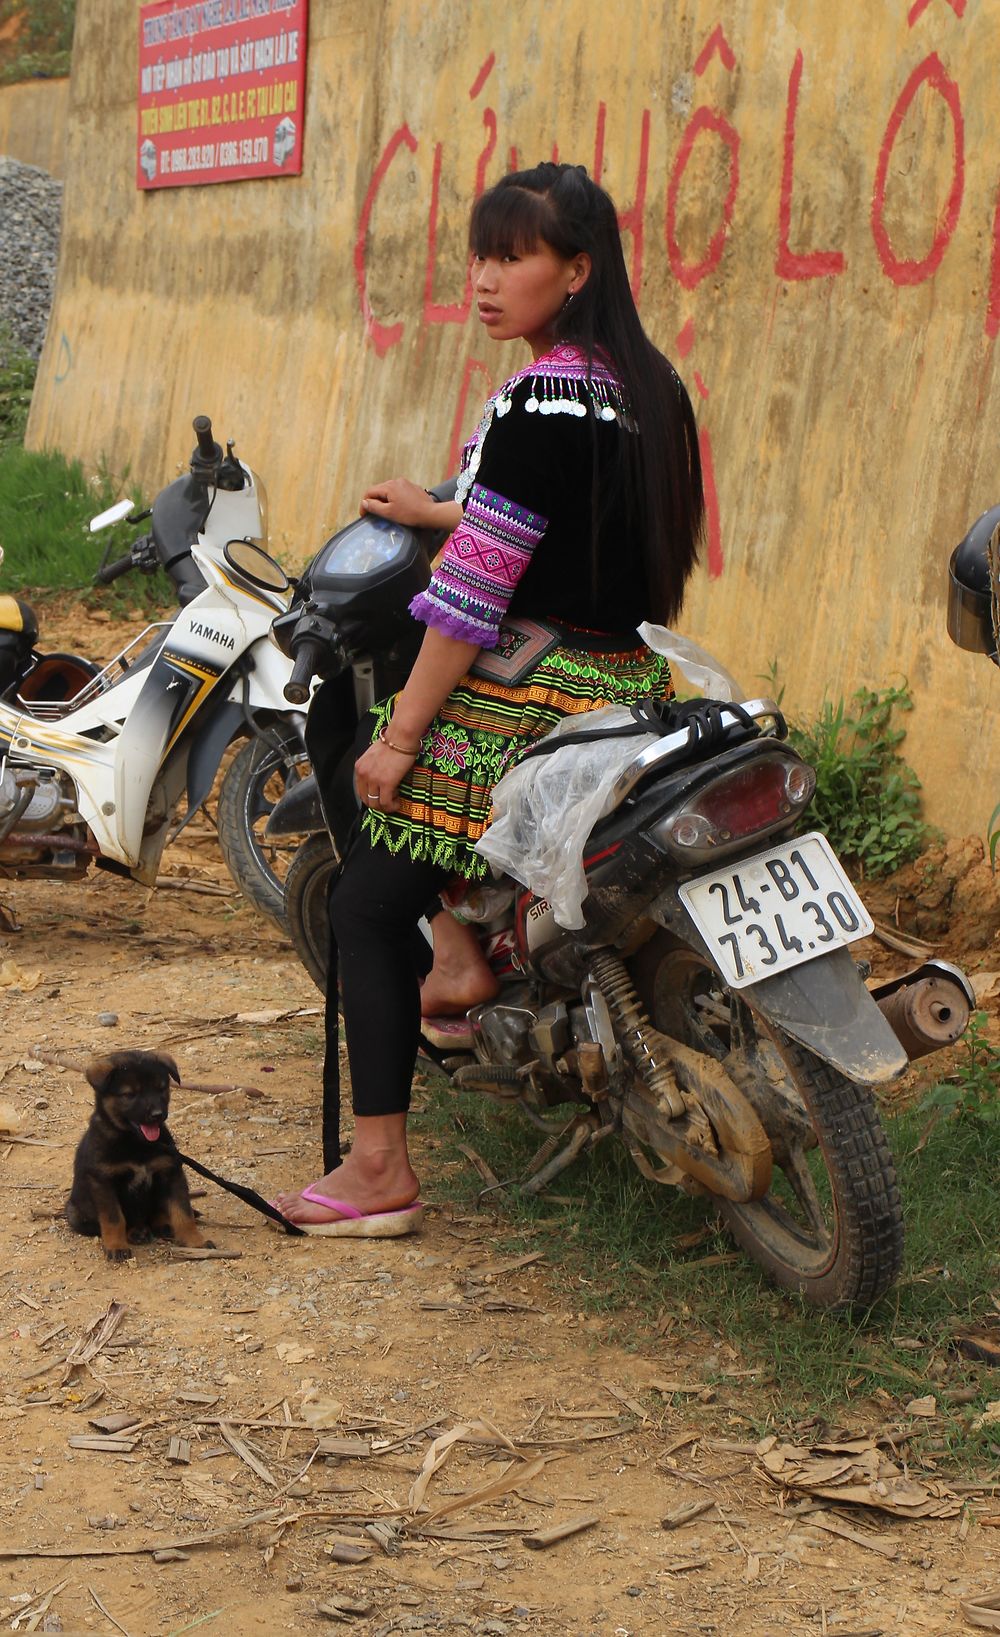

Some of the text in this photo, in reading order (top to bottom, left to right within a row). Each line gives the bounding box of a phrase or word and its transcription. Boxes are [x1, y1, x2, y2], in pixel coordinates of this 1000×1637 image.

[189, 620, 236, 650] YAMAHA
[708, 850, 820, 925] 24-B1
[717, 891, 860, 977] 734.30
